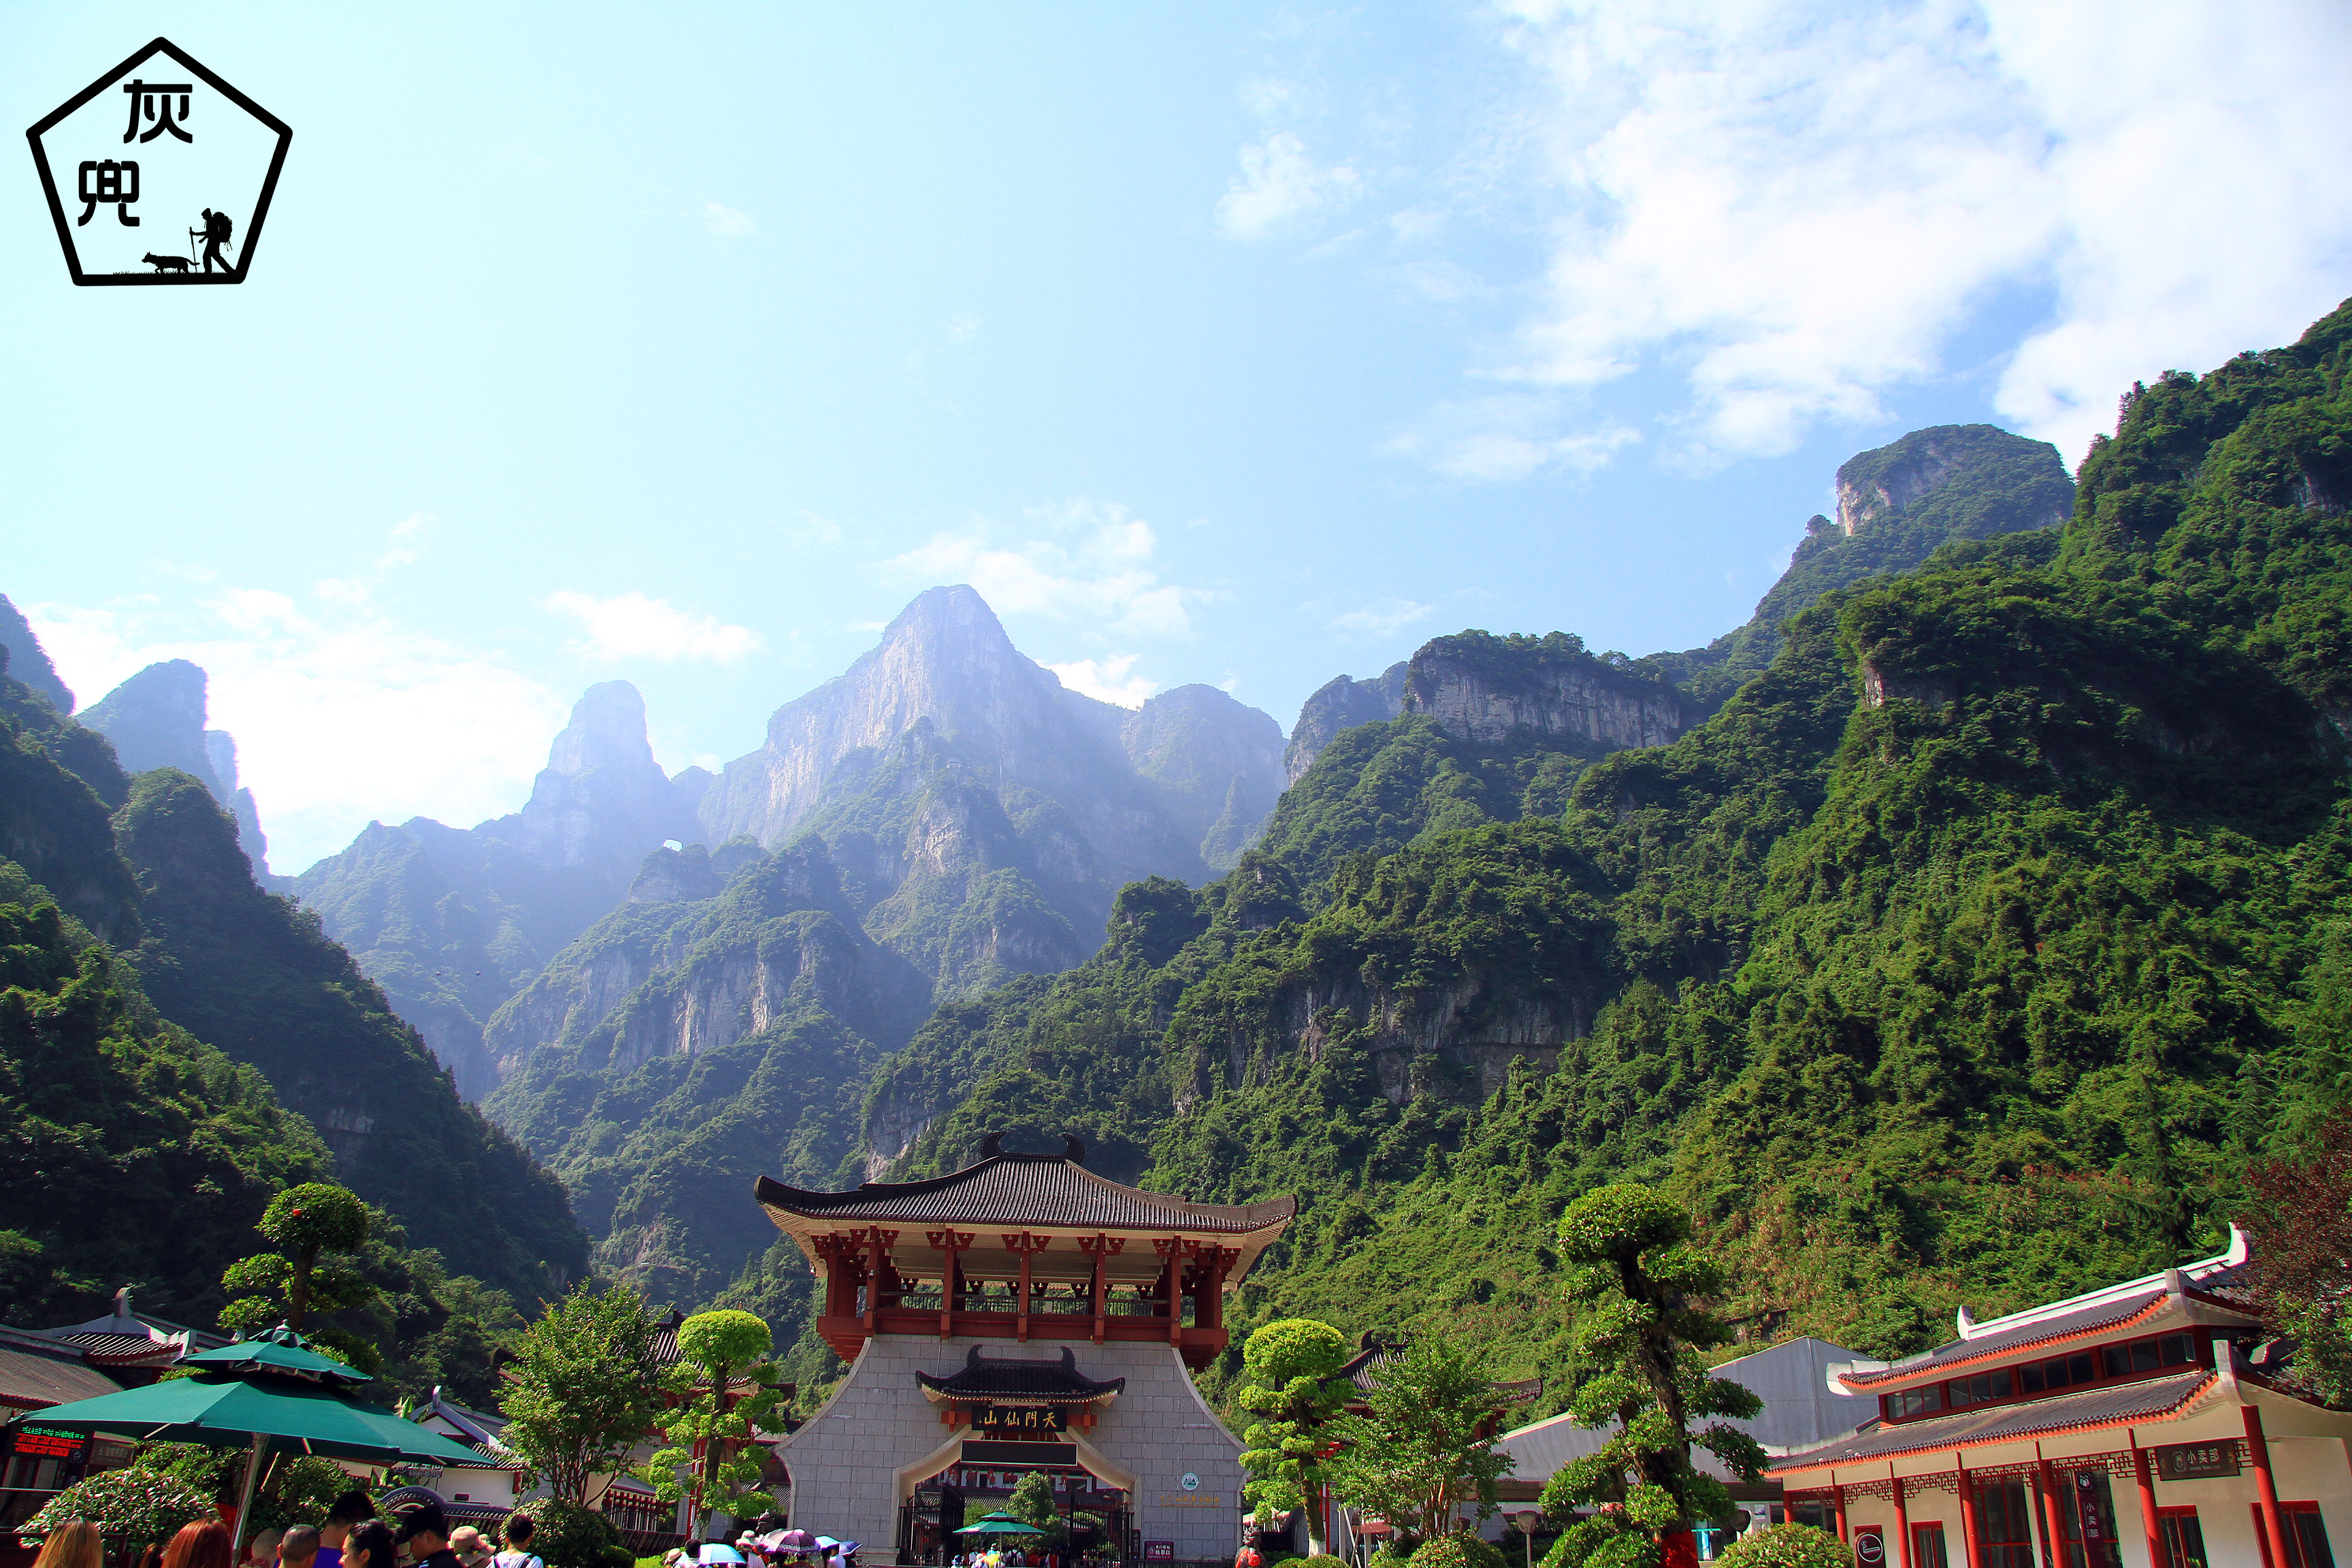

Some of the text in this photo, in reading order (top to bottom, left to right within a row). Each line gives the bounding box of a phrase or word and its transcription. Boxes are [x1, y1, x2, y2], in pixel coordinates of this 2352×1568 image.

[2187, 1448, 2219, 1464] 小卖部
[2086, 1502, 2098, 1537] 小卖部
